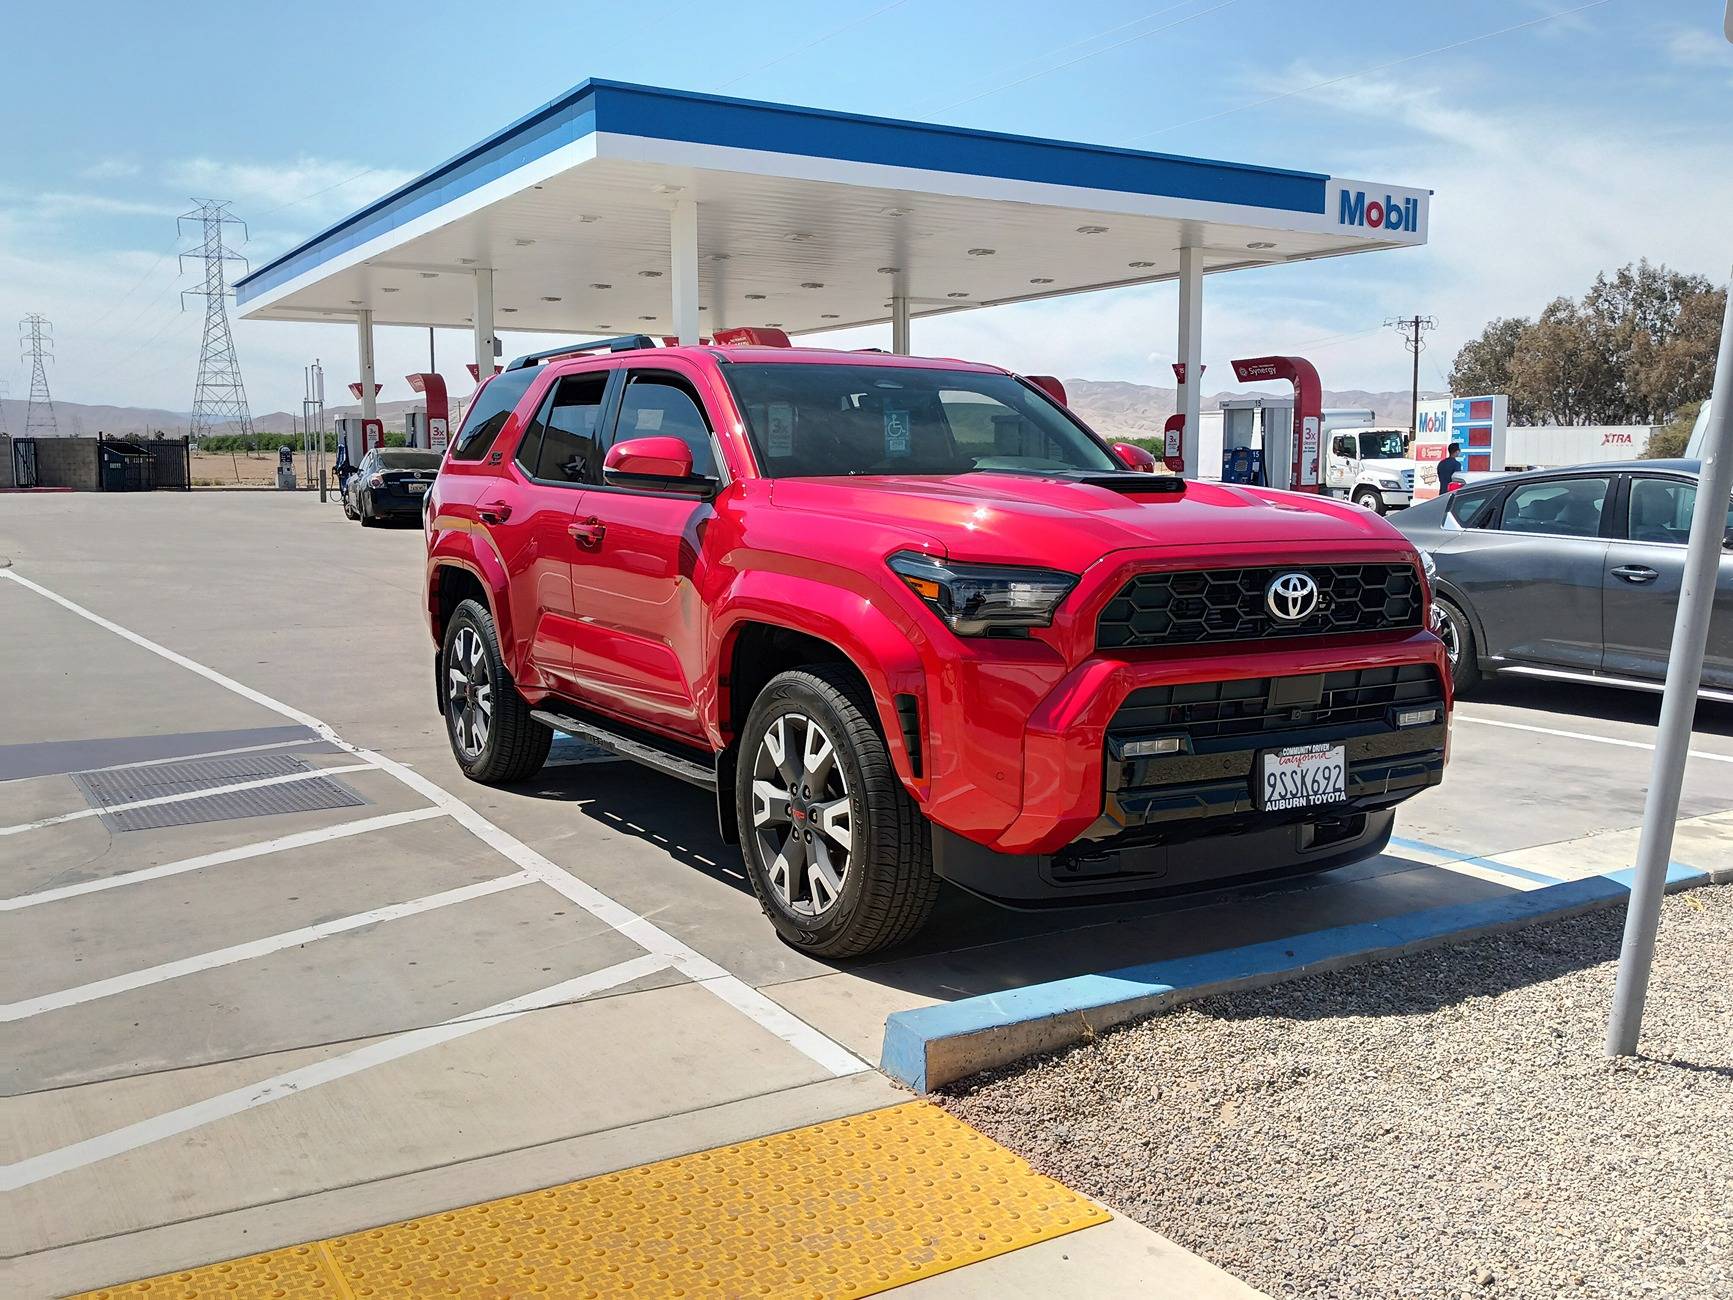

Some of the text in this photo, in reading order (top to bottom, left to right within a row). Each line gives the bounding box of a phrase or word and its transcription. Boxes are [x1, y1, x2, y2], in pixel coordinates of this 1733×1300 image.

[1339, 189, 1418, 232] Mobil
[1248, 367, 1277, 377] Synergy
[1255, 399, 1262, 407] 15
[1418, 410, 1447, 433] Mobil
[433, 426, 445, 437] 3x
[1305, 427, 1317, 440] 3x
[1169, 435, 1177, 443] 3x
[1600, 432, 1633, 446] XTRA
[1282, 743, 1330, 756] COMMUNITY DRIVEN
[1278, 752, 1331, 767] California
[1267, 764, 1342, 801] 9SSK692
[1265, 791, 1347, 812] AUBURN TOYOTA
